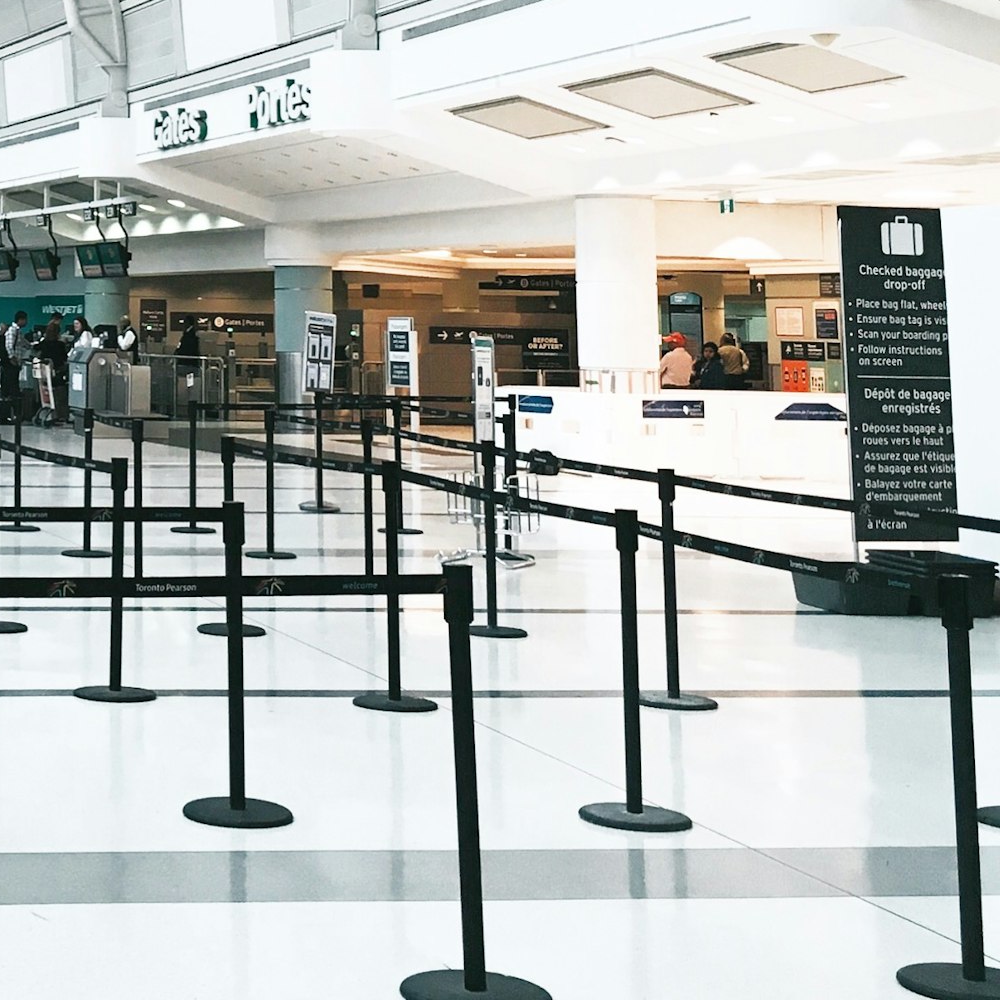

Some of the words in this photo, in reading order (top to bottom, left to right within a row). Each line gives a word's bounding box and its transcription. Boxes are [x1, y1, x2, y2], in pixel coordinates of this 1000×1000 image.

[860, 264, 902, 276] Checked
[906, 266, 944, 279] baggag
[884, 280, 926, 292] drop-off
[856, 298, 880, 308] Place
[882, 300, 898, 311] bag
[900, 300, 918, 310] flat,
[920, 300, 947, 310] wheel
[856, 314, 888, 324] Ensure
[889, 314, 906, 326] bag
[908, 315, 922, 326] tag
[924, 316, 932, 325] is
[858, 329, 879, 339] Scan
[880, 331, 900, 340] your
[902, 330, 940, 342] boarding
[858, 344, 886, 354] Follow
[888, 345, 942, 355] instructions
[858, 358, 870, 366] on
[872, 358, 902, 366] screen
[864, 388, 896, 400] Dépôt
[898, 389, 910, 399] de
[882, 403, 941, 416] enregistrés
[862, 422, 900, 434] Déposez
[902, 424, 936, 434] bagage
[938, 424, 944, 433] à
[862, 437, 888, 446] roues
[890, 437, 910, 446] vers
[912, 436, 920, 446] le
[923, 436, 944, 446] haut
[864, 451, 900, 460] Assurez
[902, 452, 920, 462] que
[864, 464, 876, 473] de
[878, 464, 912, 475] bagage
[914, 465, 928, 473] est
[864, 478, 900, 490] Balayez
[902, 479, 927, 489] votre
[929, 480, 952, 489] carte
[866, 492, 942, 502] d'embarquement
[867, 520, 874, 529] à
[876, 520, 907, 529] l'écran
[136, 583, 164, 592] Toronto
[166, 583, 196, 592] Pearson
